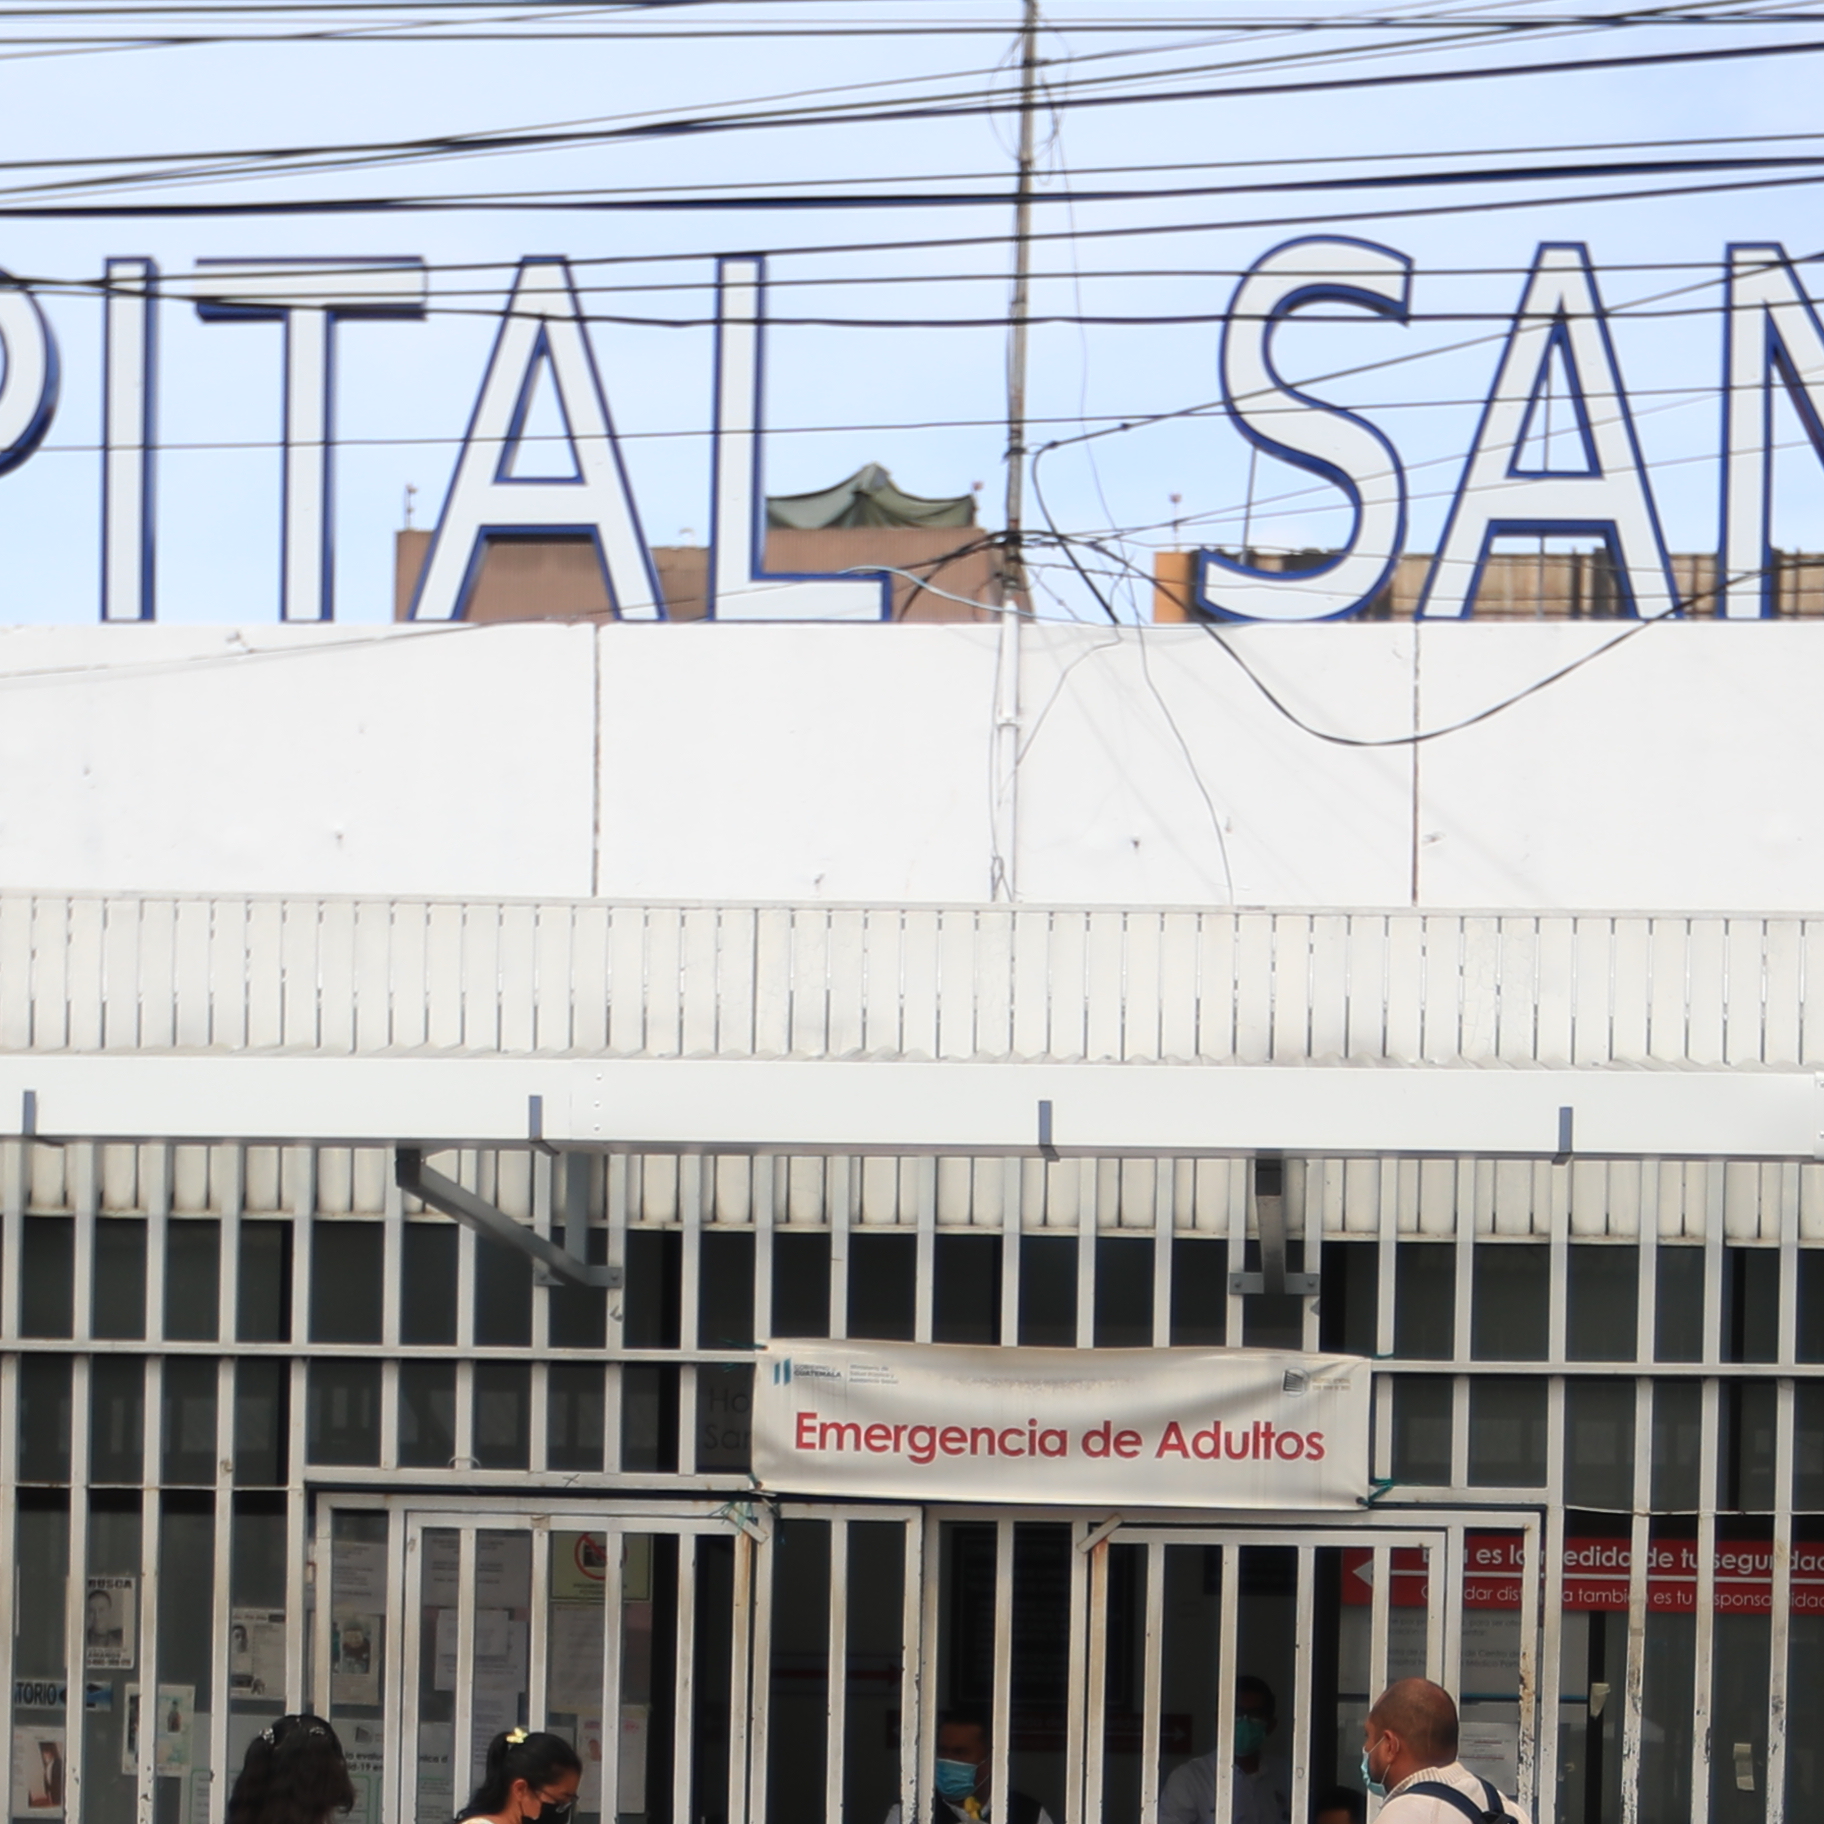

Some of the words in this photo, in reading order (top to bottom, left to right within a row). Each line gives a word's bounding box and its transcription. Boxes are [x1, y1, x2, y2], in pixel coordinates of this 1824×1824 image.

[795, 1411, 1067, 1465] Emergencia
[1081, 1420, 1143, 1460] de
[1155, 1420, 1326, 1463] Adultos
[1476, 1549, 1502, 1565] es
[1540, 1546, 1632, 1570] edida
[1653, 1591, 1673, 1605] es
[1677, 1590, 1693, 1606] tu
